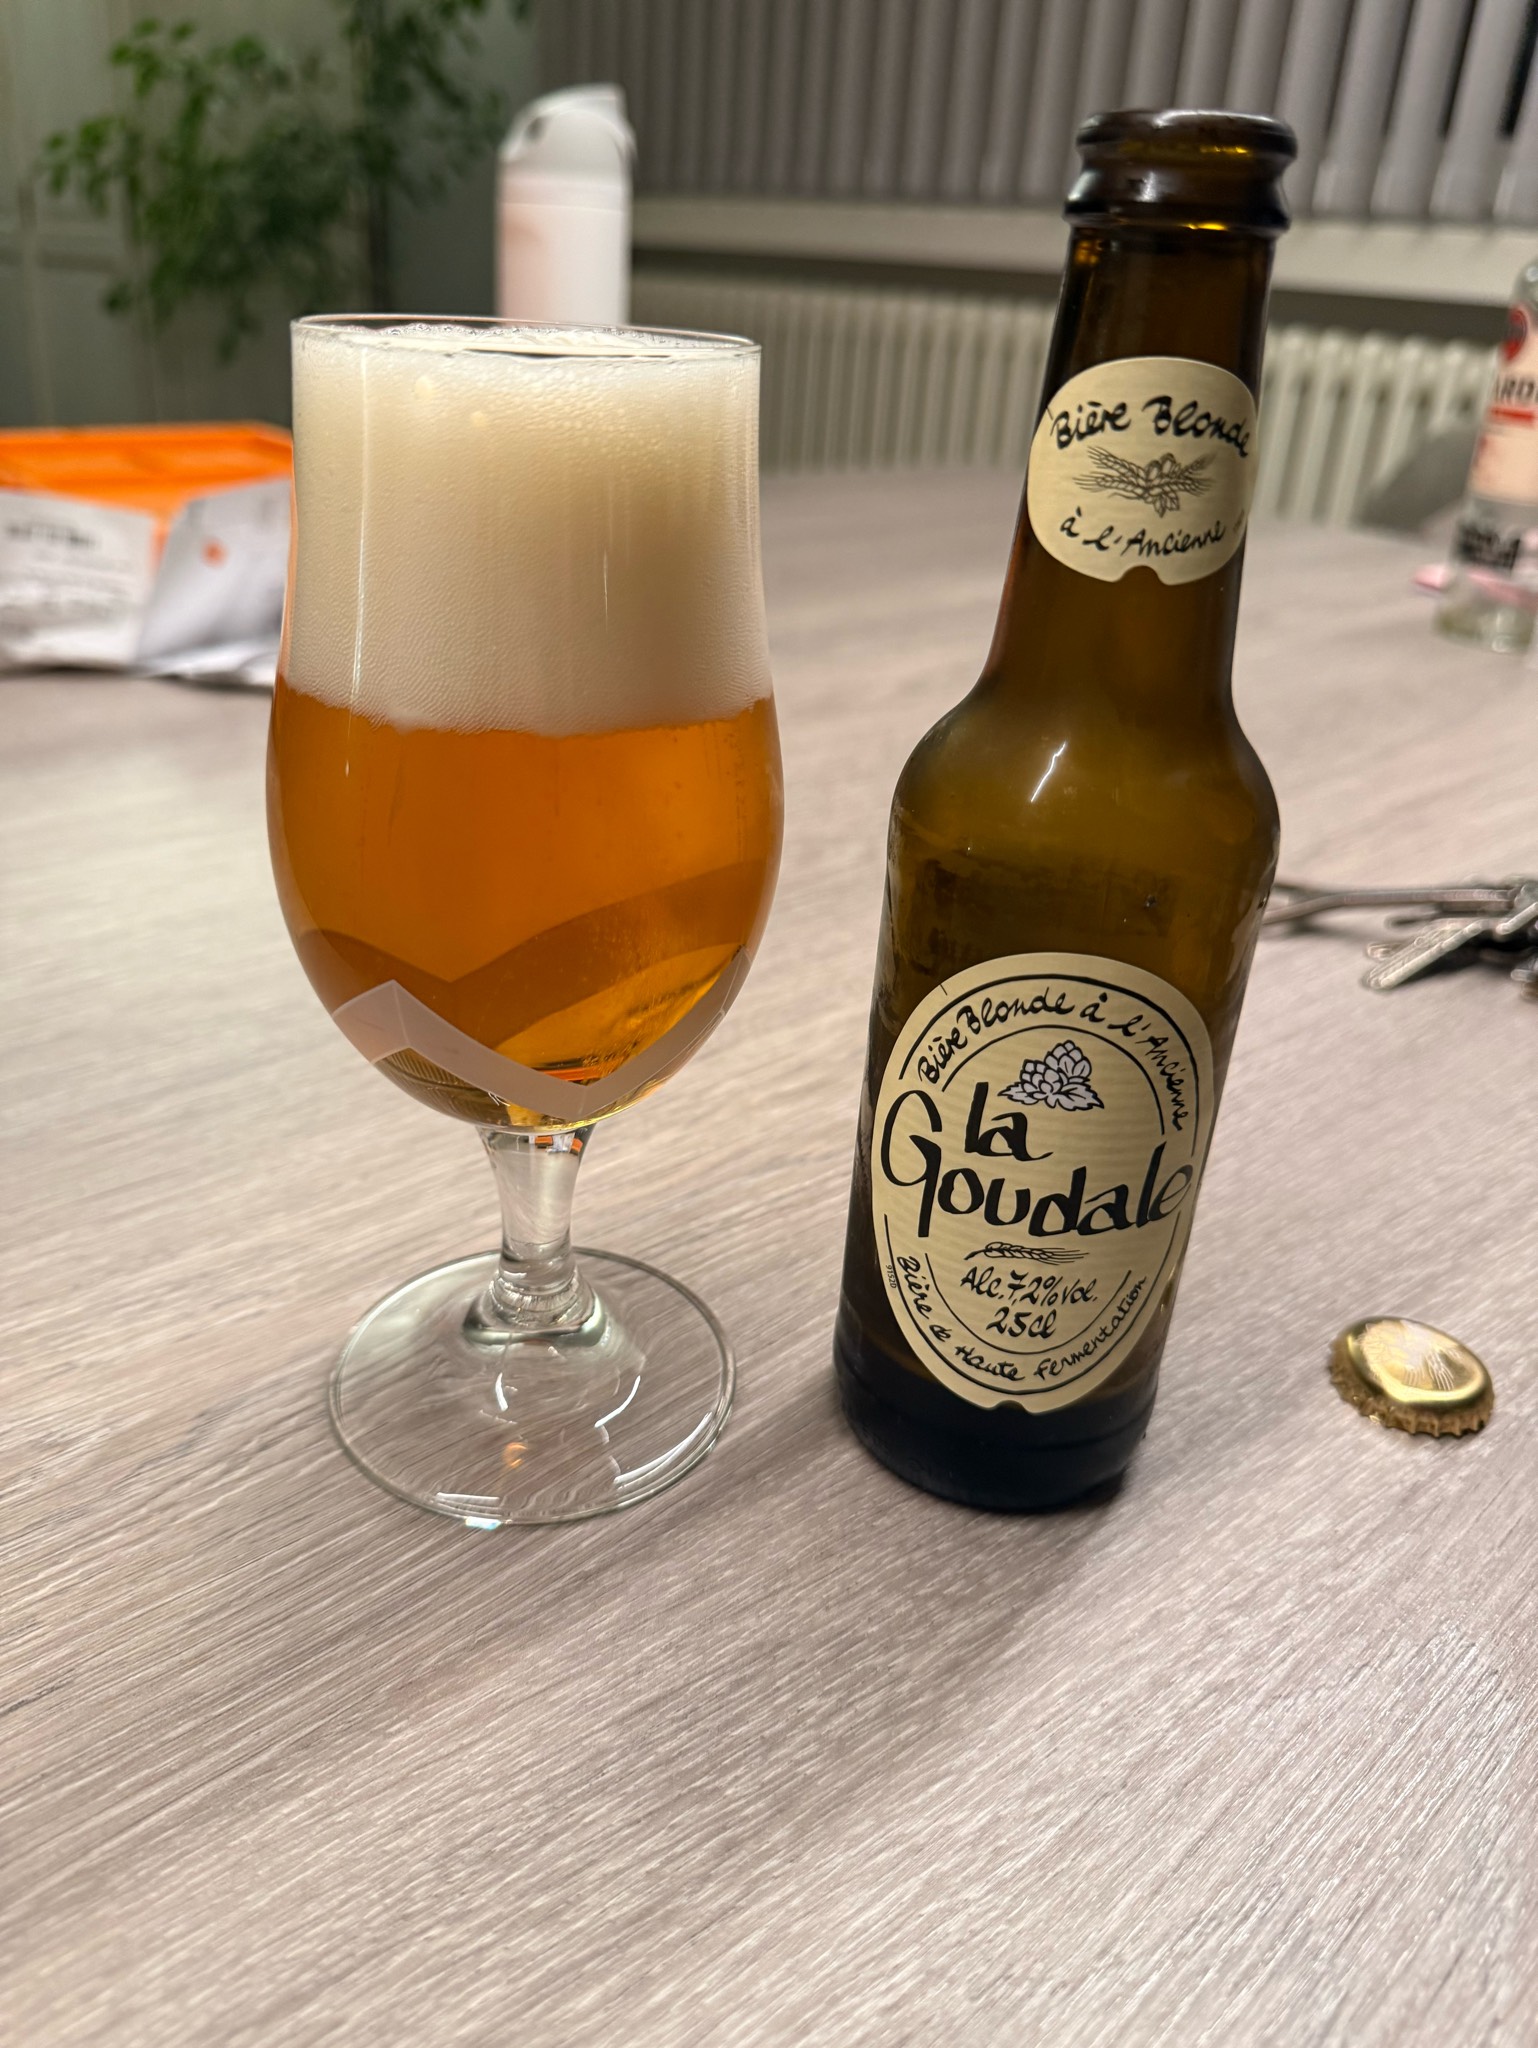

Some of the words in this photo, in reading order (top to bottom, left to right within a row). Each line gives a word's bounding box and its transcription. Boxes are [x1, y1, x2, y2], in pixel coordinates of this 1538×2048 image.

[1050, 401, 1132, 450] Bière
[1142, 395, 1250, 459] Blonde
[1060, 505, 1082, 539] à
[1082, 519, 1226, 557] l'Ancienne
[917, 1026, 968, 1085] Bière
[956, 986, 1076, 1035] Blonde
[1080, 991, 1108, 1023] à
[1107, 1014, 1189, 1132] l'Ancienne
[880, 1089, 1194, 1238] Goudale
[896, 1255, 933, 1320] Bière
[928, 1324, 953, 1343] de
[954, 1345, 1026, 1381] Haute
[960, 1265, 1005, 1300] Alc.
